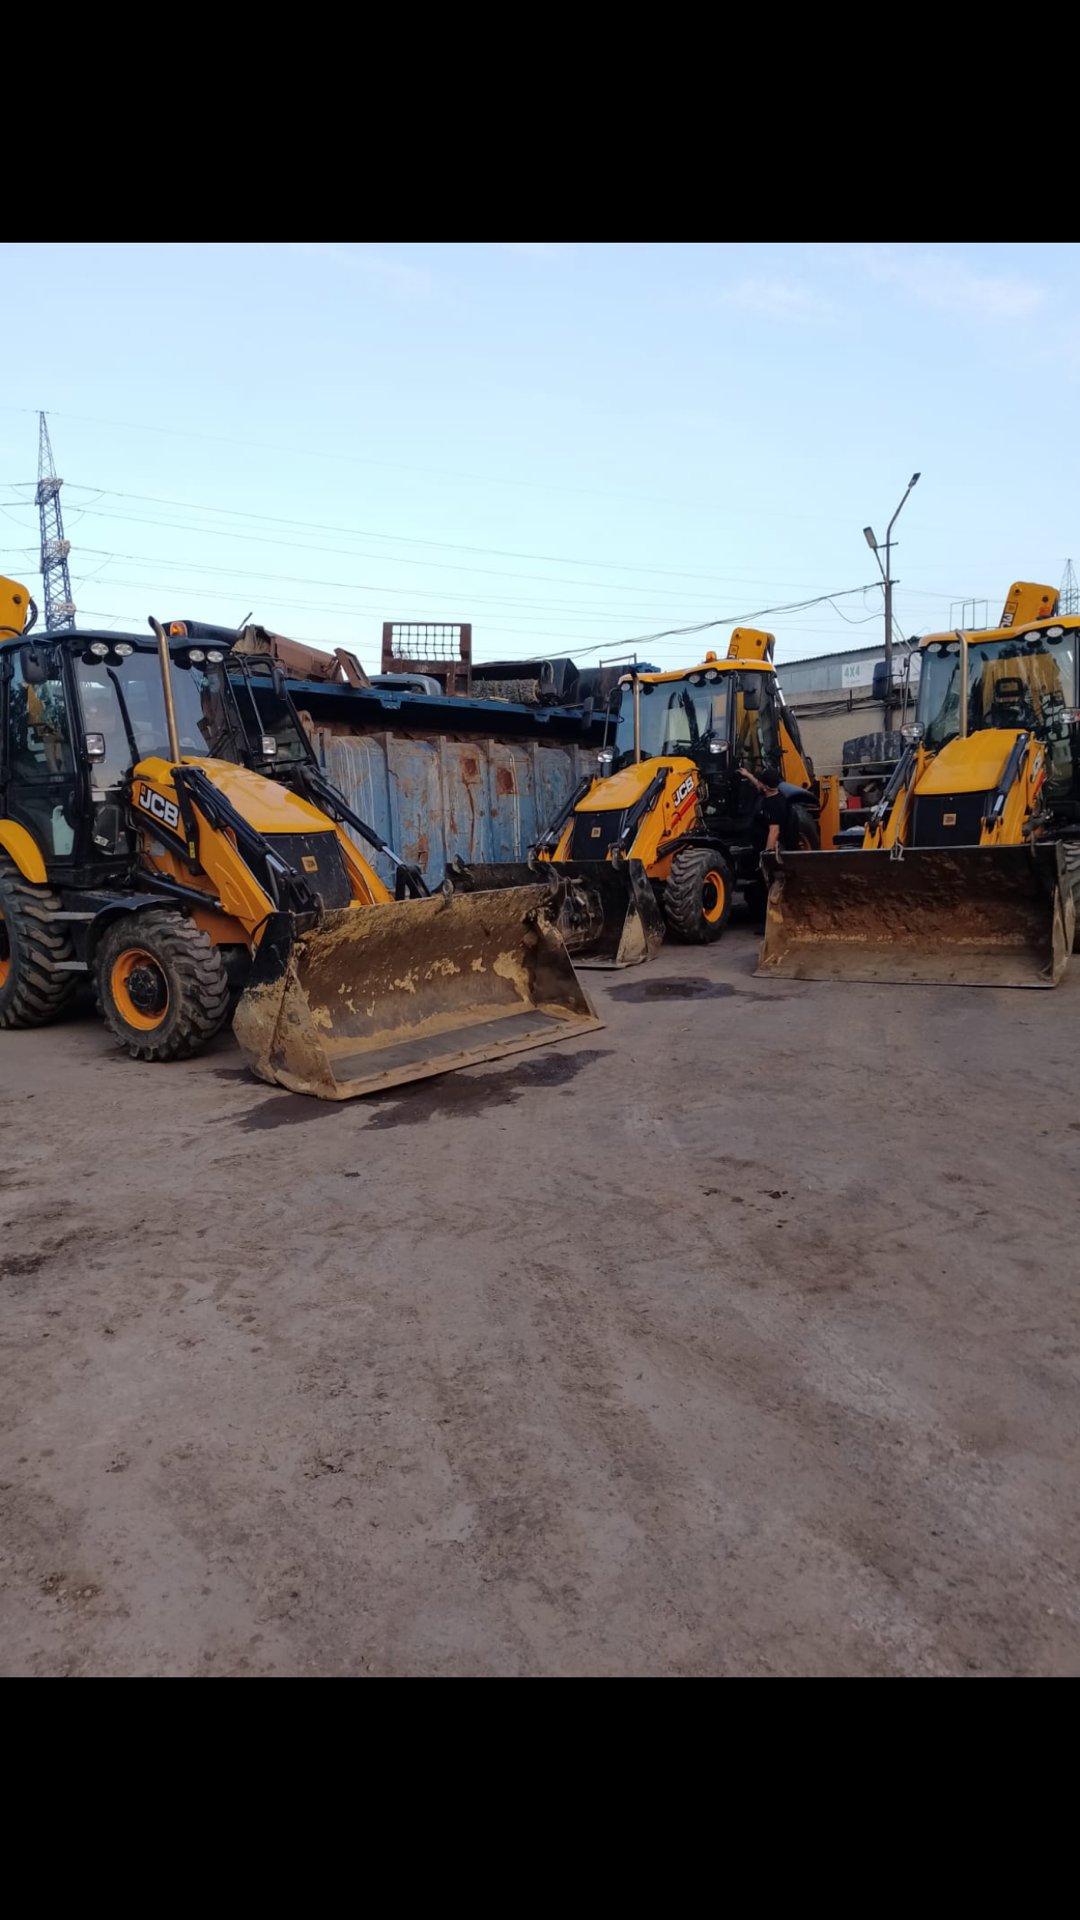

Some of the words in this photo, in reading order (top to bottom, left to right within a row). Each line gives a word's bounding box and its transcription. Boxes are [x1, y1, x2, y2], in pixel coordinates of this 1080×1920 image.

[844, 665, 860, 678] 4X4
[675, 776, 694, 806] JCB
[140, 789, 179, 827] JCB
